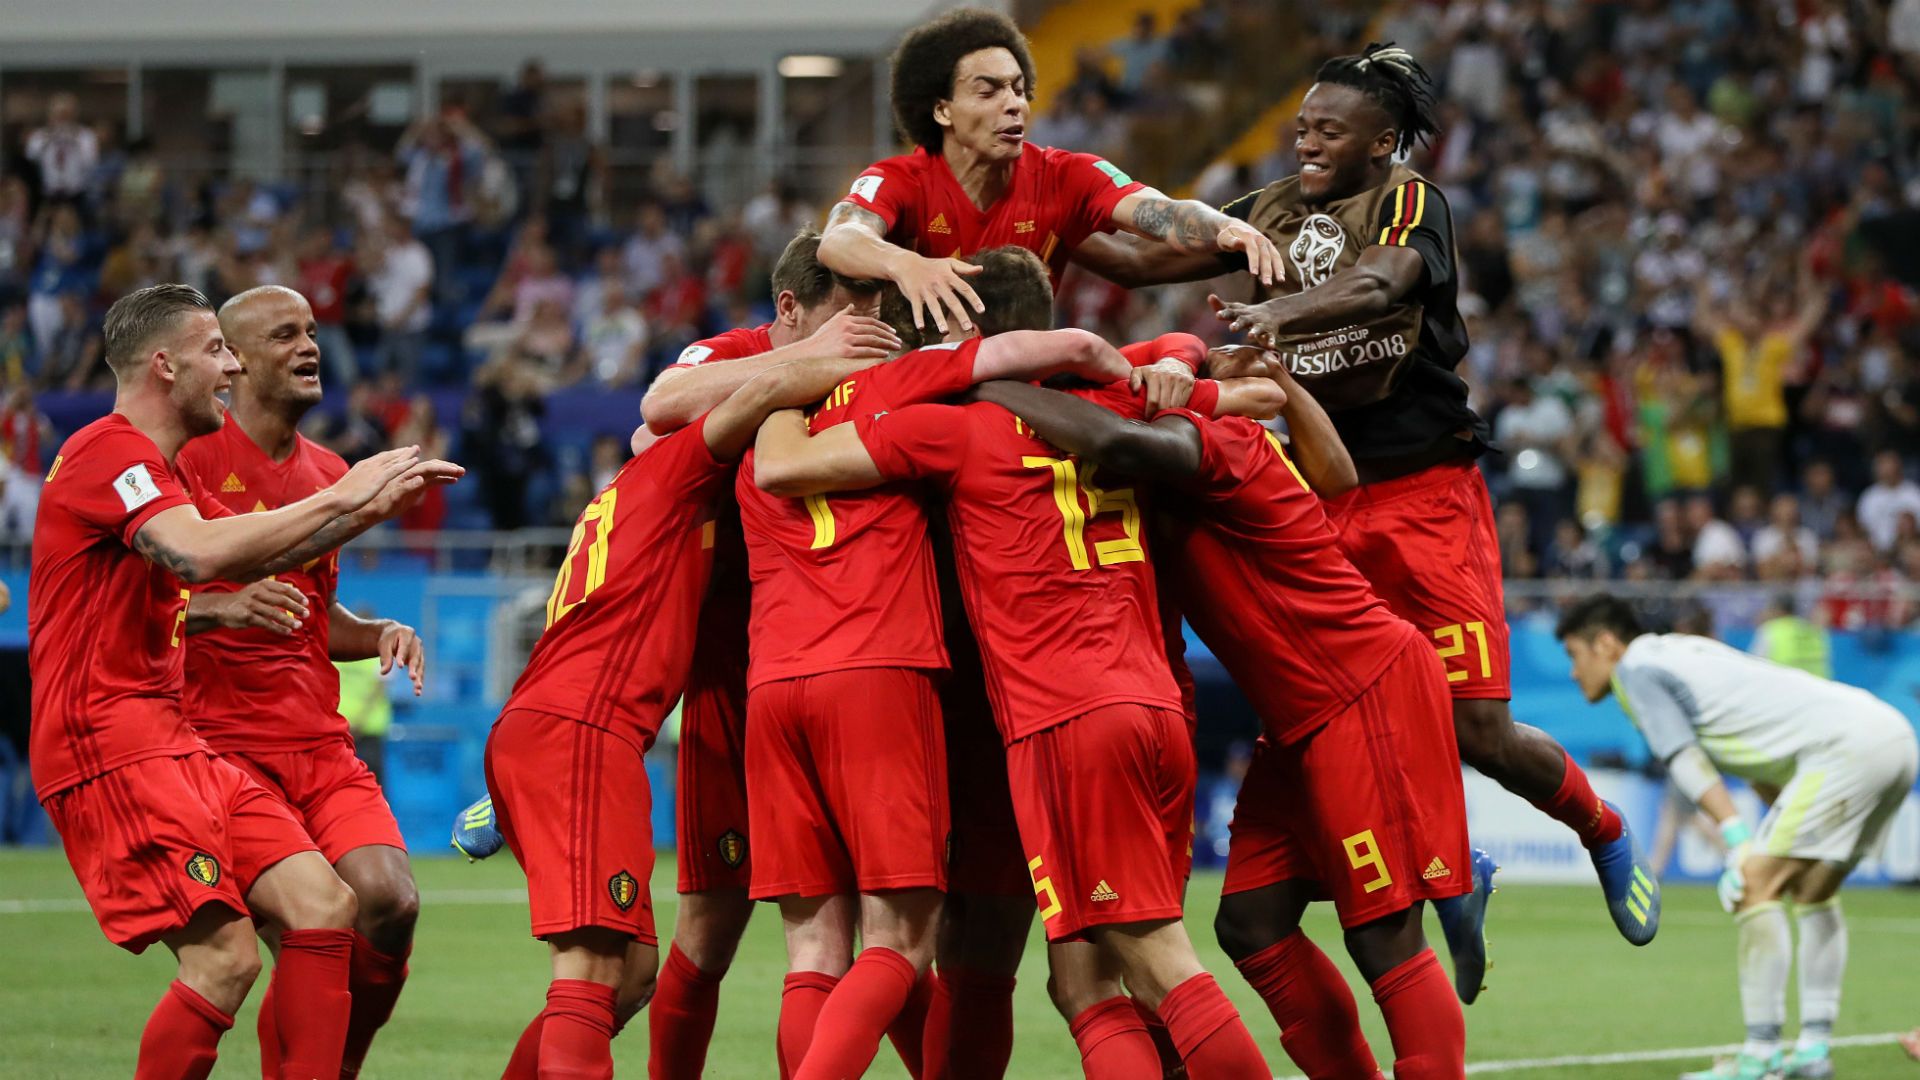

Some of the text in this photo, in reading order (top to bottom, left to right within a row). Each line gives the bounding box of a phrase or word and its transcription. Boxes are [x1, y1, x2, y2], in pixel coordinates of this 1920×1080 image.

[1315, 334, 1348, 349] WORLD
[1348, 328, 1369, 342] CUP
[1350, 334, 1406, 367] 2018
[1022, 456, 1146, 571] 15
[1434, 621, 1492, 682] 21
[1342, 829, 1393, 894] 9
[1423, 868, 1451, 880] adidas
[1090, 892, 1119, 902] adidas
